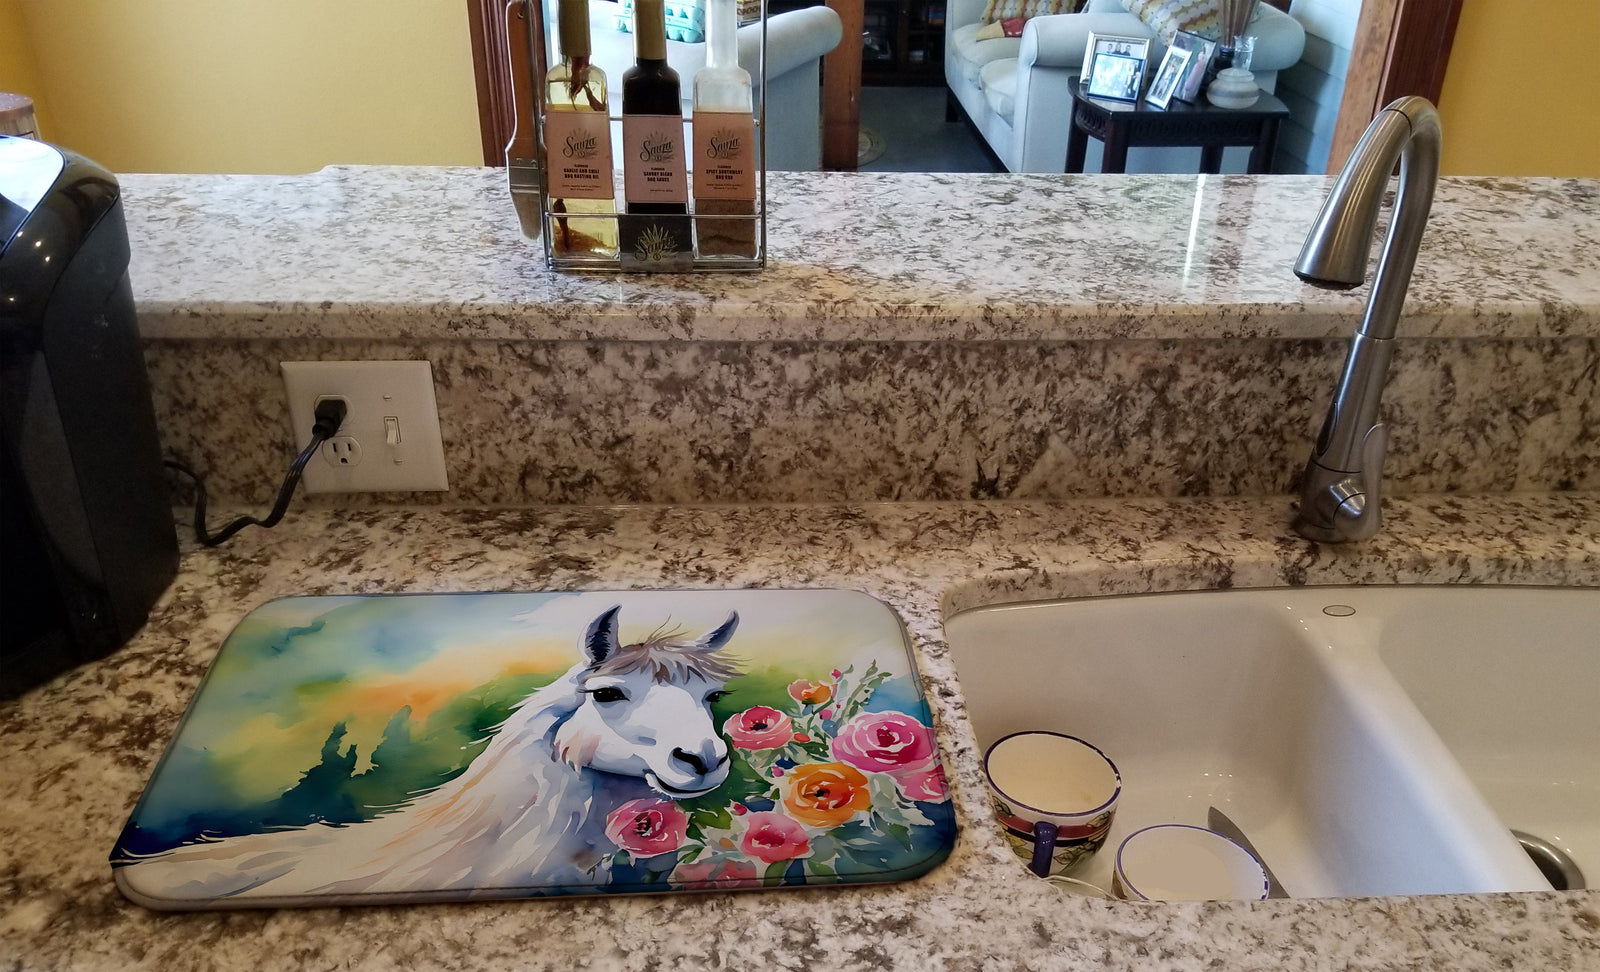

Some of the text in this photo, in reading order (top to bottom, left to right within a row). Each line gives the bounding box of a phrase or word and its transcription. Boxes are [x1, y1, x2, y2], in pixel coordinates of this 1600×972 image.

[562, 136, 597, 158] Sauza
[639, 140, 673, 162] Sauza
[706, 136, 741, 159] Sauza
